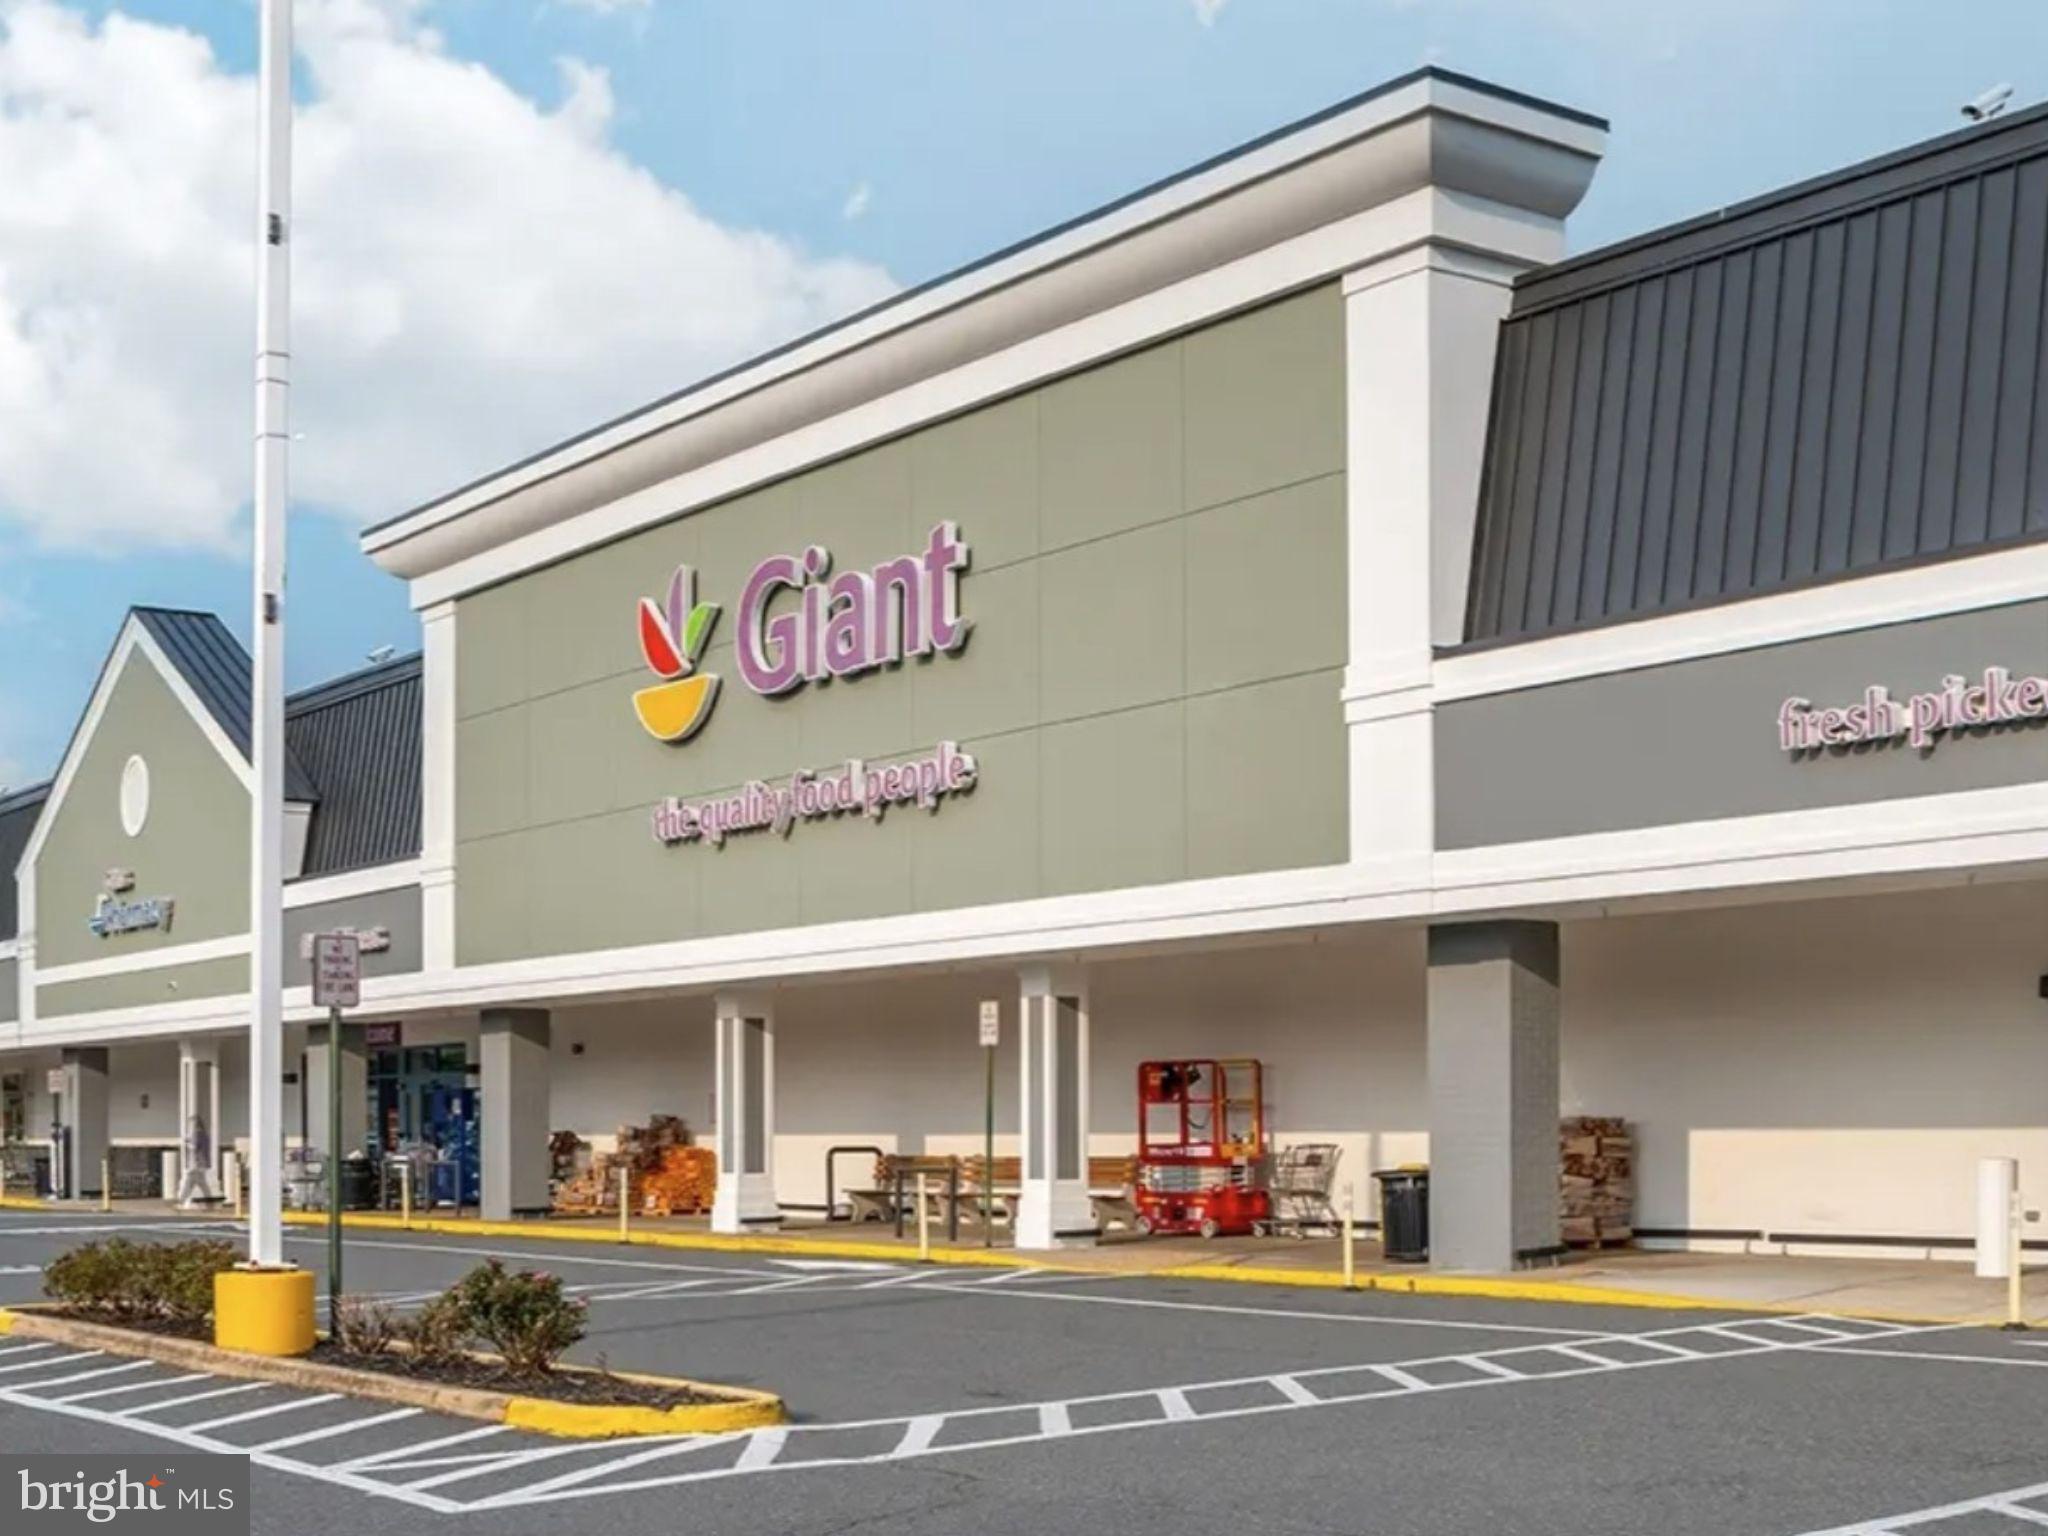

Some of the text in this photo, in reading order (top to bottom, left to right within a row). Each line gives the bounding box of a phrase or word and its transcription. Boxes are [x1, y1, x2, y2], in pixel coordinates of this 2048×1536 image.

[736, 520, 973, 694] Giant
[1778, 665, 2048, 750] fresh picke
[653, 740, 977, 845] the quality food people
